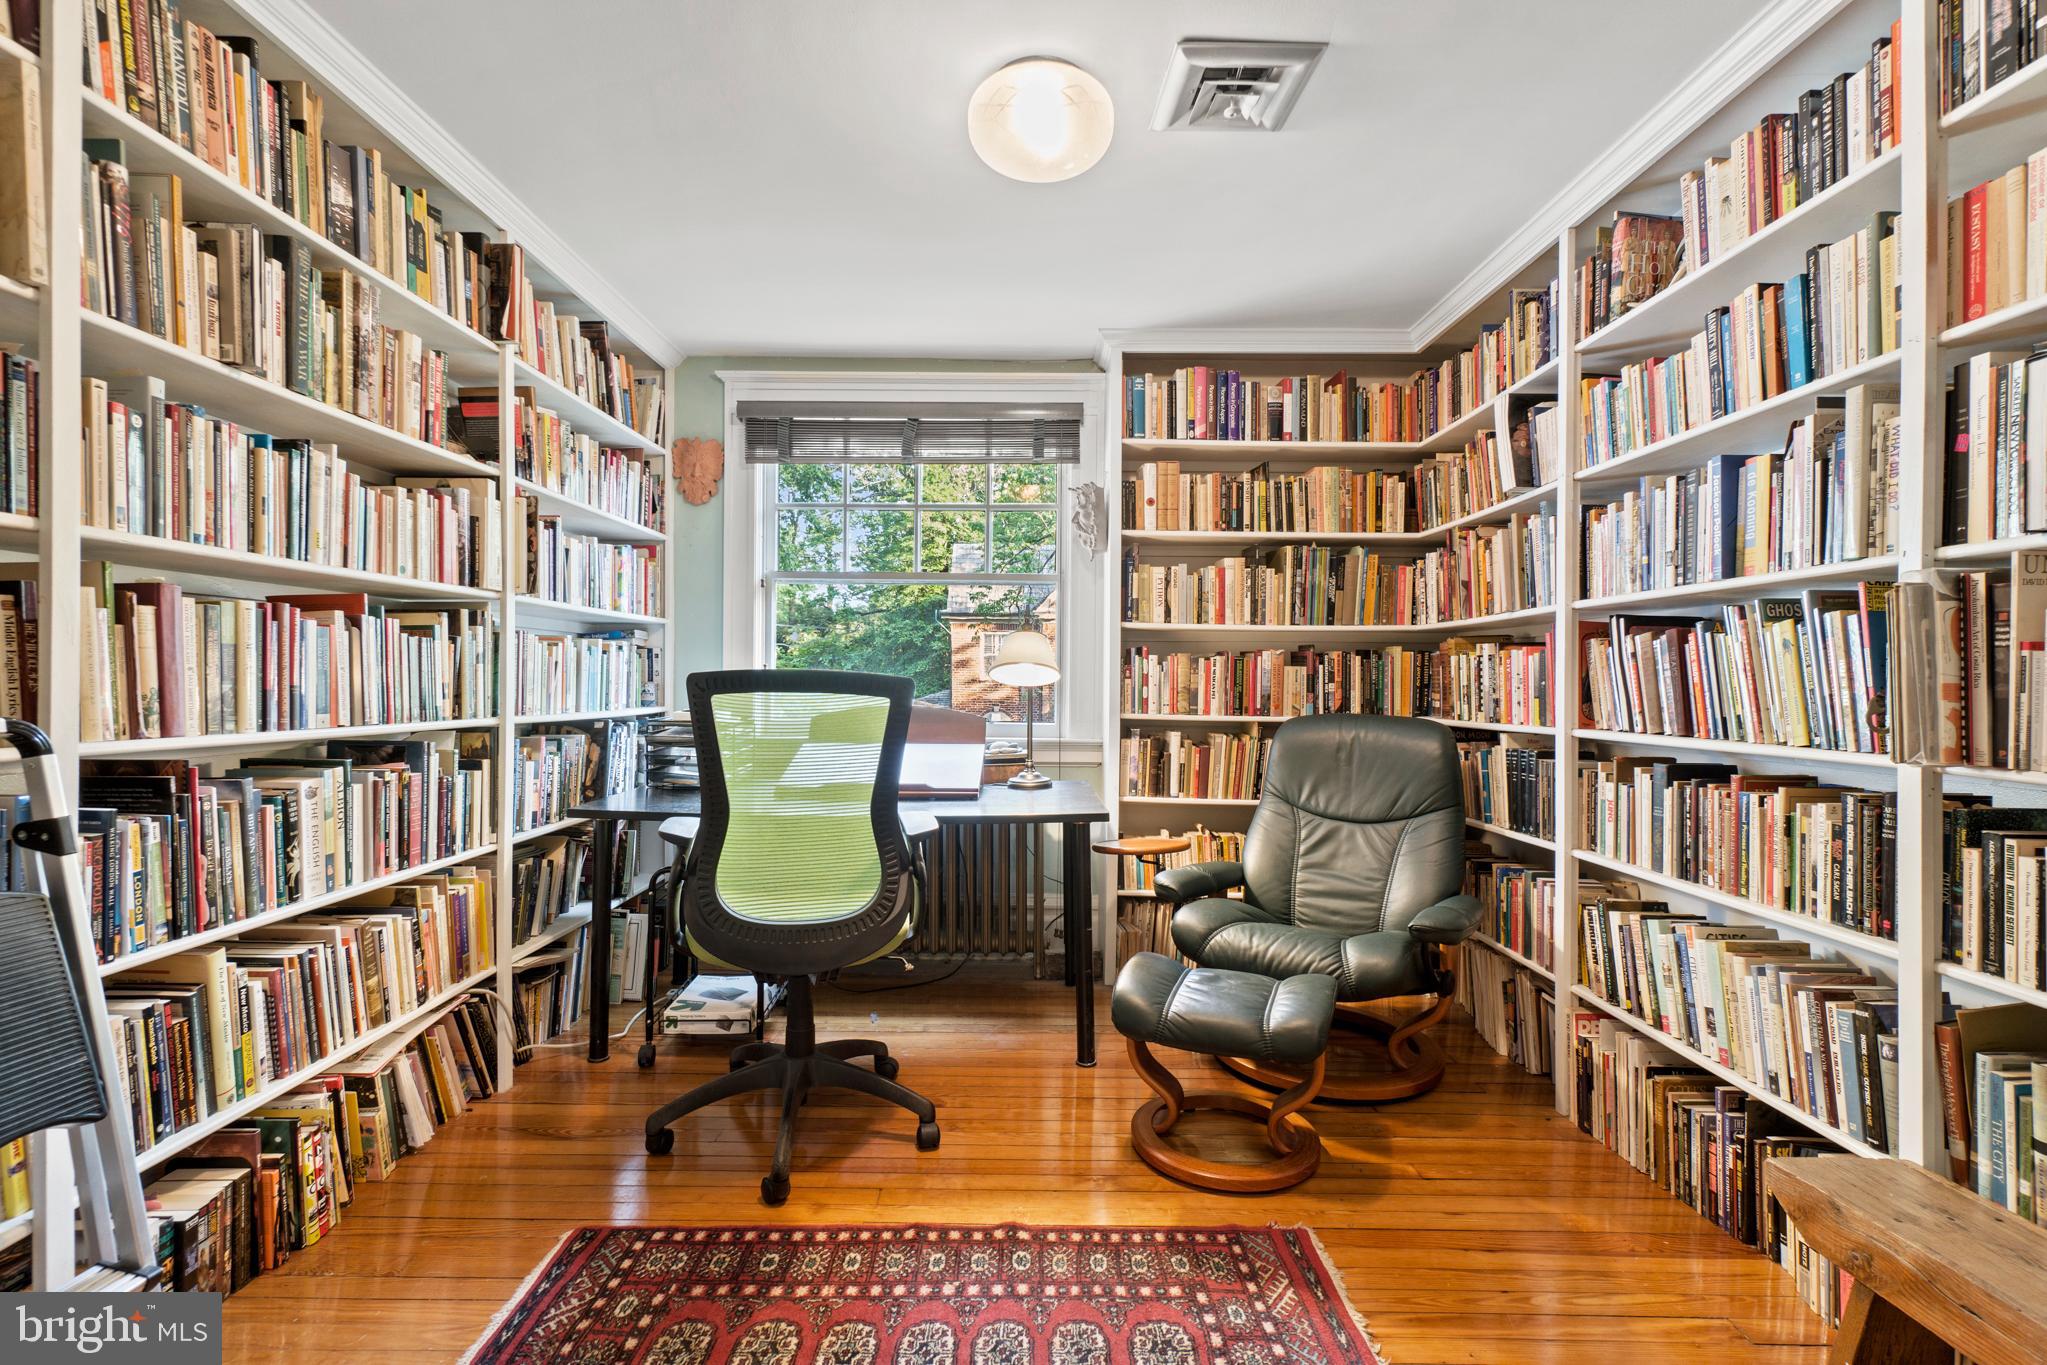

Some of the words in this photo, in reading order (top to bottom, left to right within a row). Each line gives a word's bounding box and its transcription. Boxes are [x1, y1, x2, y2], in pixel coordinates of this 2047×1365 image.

[141, 34, 151, 84] AMERICAN
[201, 32, 213, 60] Saga
[170, 36, 189, 113] MANITOU
[204, 62, 218, 111] America
[1881, 94, 1889, 110] LILY
[1882, 112, 1890, 131] DALE
[112, 202, 133, 242] 1776
[1971, 203, 1980, 250] ECSTASY
[300, 274, 309, 302] THE
[299, 306, 308, 345] CIVIL
[1707, 312, 1717, 348] HAMLET'S
[298, 349, 307, 380] WAR
[1709, 350, 1717, 368] MILL
[15, 384, 25, 408] Maine
[2012, 376, 2020, 413] SANDLER
[16, 412, 26, 435] Coast
[2010, 414, 2019, 442] NEW
[1890, 426, 1900, 458] WHAT
[17, 448, 27, 475] Islands
[1889, 462, 1900, 478] DID
[1747, 472, 1756, 486] de
[1746, 492, 1756, 539] Kooning
[1156, 577, 1164, 607] PYTHON
[1971, 579, 1980, 627] Precolumbian
[1766, 602, 1802, 618] GHOS
[4, 615, 14, 647] Middle
[1973, 642, 1980, 650] of
[6, 650, 17, 684] English
[1973, 651, 1981, 671] Costa
[1974, 672, 1982, 688] Rica
[8, 687, 20, 716] Lyrics
[337, 780, 345, 830] ALBION
[248, 814, 256, 853] BRITAIN
[312, 825, 320, 868] ENGLISH
[92, 839, 103, 914] NECROPOLIS
[224, 846, 232, 884] ROSSLYN
[2006, 844, 2014, 881] AUTHORITY
[134, 875, 143, 922] LONDON
[2006, 884, 2015, 915] RICHARD
[2006, 916, 2014, 946] SENNETT
[240, 988, 248, 1006] New
[147, 1018, 156, 1047] Dancing
[241, 1006, 250, 1032] Mexico
[1992, 1120, 2003, 1145] THE
[1992, 1149, 2005, 1184] CITY
